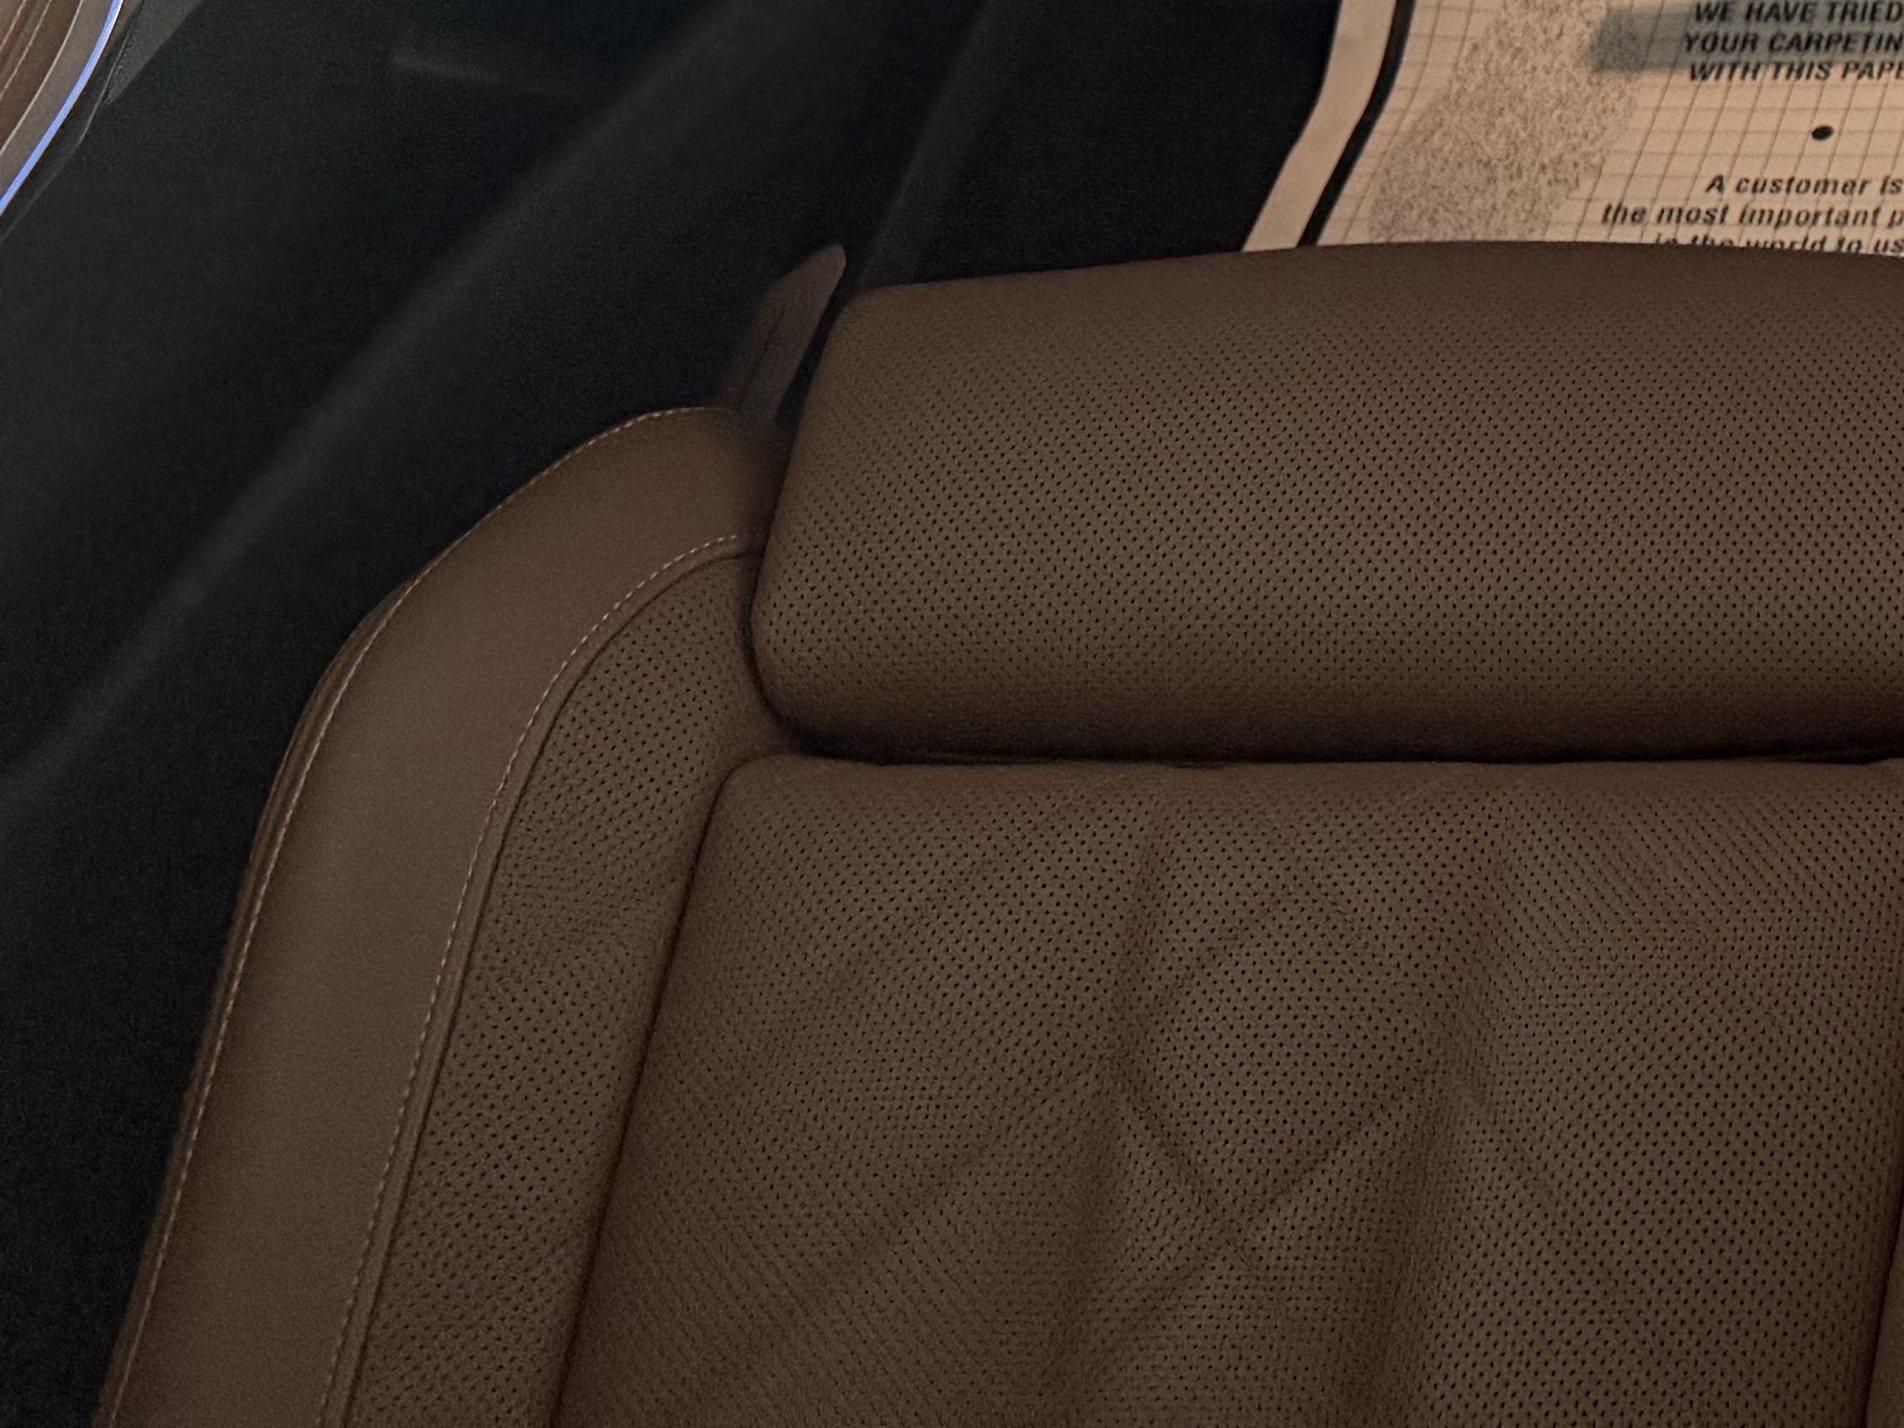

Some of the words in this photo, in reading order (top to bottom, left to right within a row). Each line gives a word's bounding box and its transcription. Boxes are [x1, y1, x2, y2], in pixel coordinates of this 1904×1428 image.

[1695, 2, 1737, 22] WE
[1745, 1, 1816, 23] HAVE
[1826, 1, 1904, 22] TRIED
[1684, 32, 1758, 53] YOUR
[1690, 62, 1760, 81] WITH
[1772, 62, 1831, 80] THIS
[1706, 176, 1724, 193] A
[1735, 176, 1870, 194] customer
[1880, 176, 1904, 194] is
[1602, 204, 1646, 224] the
[1658, 204, 1729, 225] most
[1740, 204, 1880, 227] important
